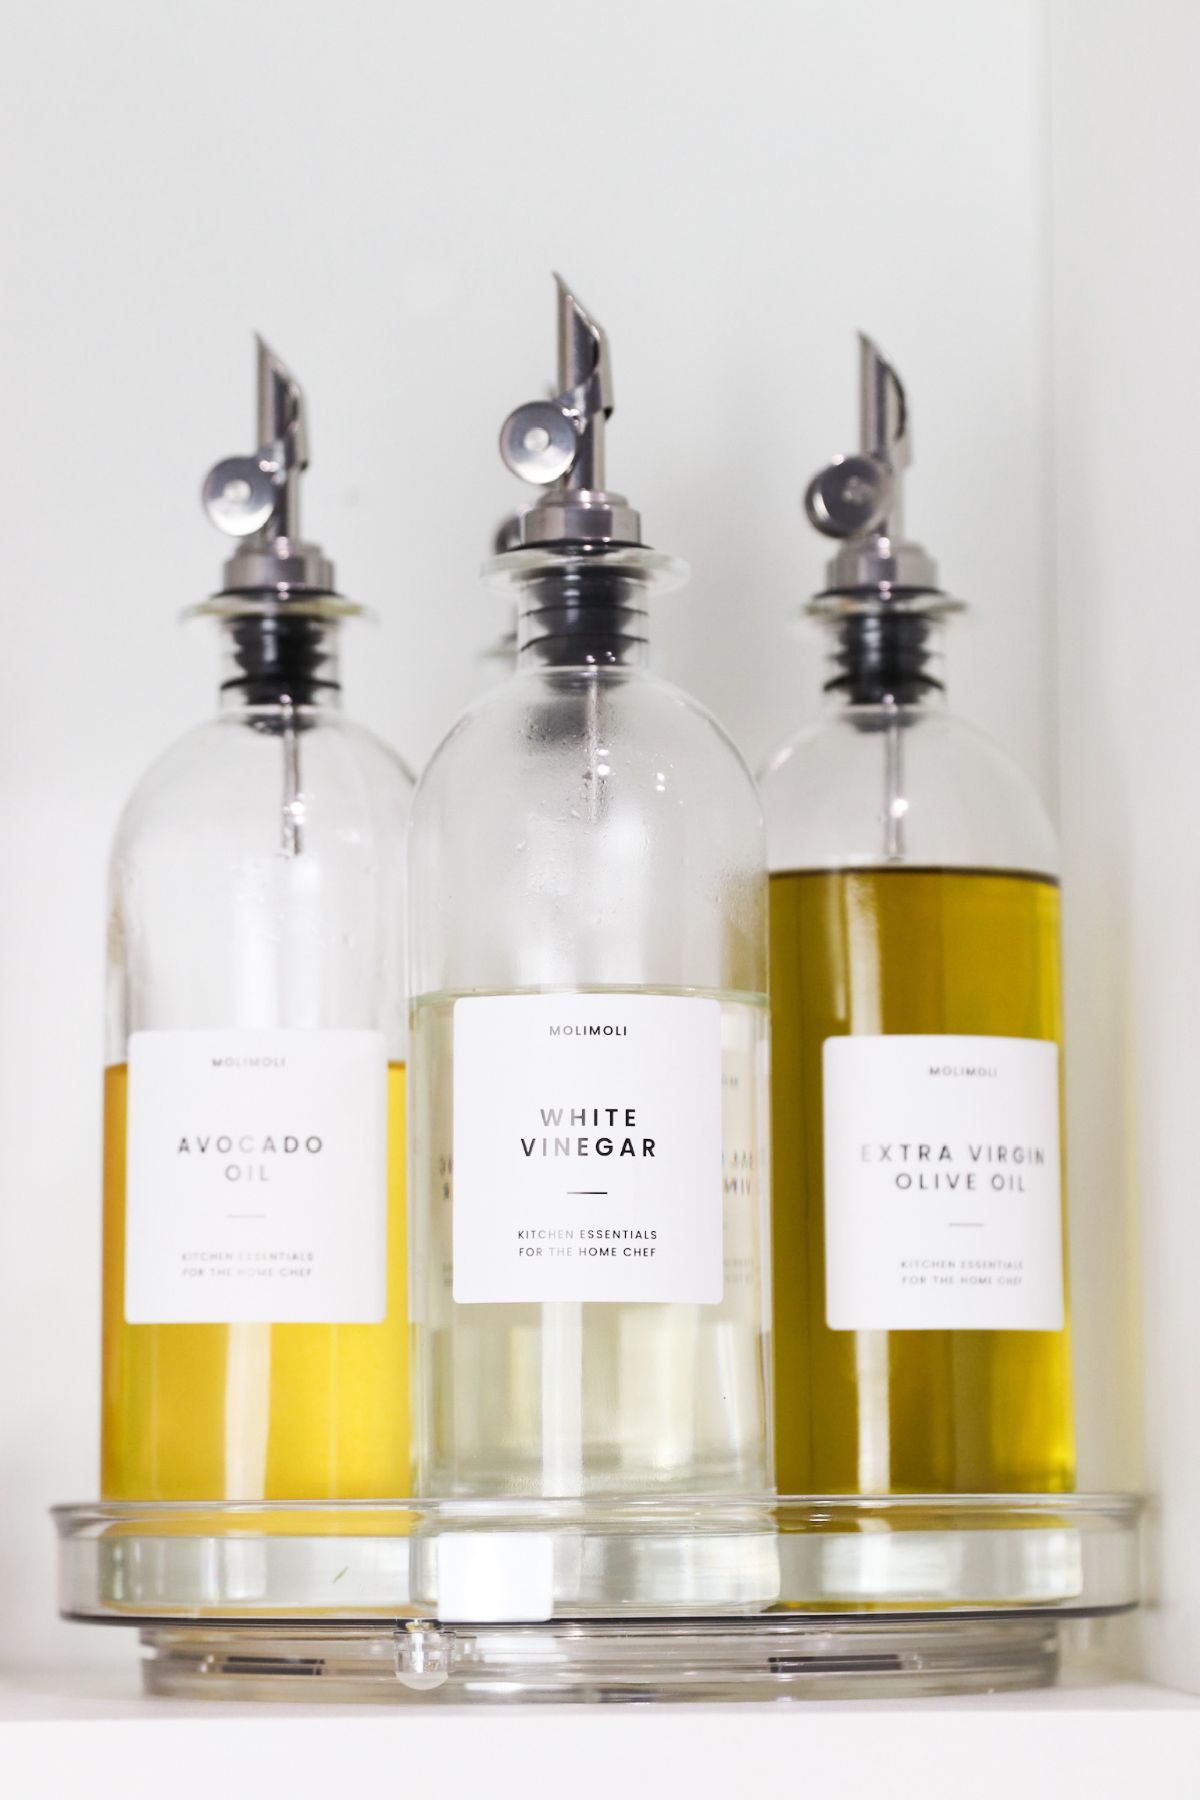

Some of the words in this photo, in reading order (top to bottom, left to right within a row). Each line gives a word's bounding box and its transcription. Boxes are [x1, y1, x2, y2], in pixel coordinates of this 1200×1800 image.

[549, 1025, 627, 1036] MOLIMOLI
[929, 1066, 998, 1077] MOLIMOLI
[540, 1108, 636, 1127] WHITE
[177, 1135, 323, 1154] AVOCADO
[520, 1137, 656, 1157] VINEGAR
[860, 1144, 953, 1163] EXTRA
[968, 1144, 1045, 1165] VIRGIN
[224, 1164, 269, 1182] OIL
[895, 1173, 977, 1191] OLIVE
[991, 1173, 1025, 1193] OIL
[518, 1229, 574, 1240] KITCHEN
[579, 1229, 658, 1240] ESSENTIALS
[518, 1247, 543, 1257] FOR
[549, 1247, 573, 1257] THE
[578, 1247, 618, 1257] HOME
[623, 1247, 656, 1257] CHEF
[901, 1259, 956, 1270] KITCHEN
[901, 1275, 927, 1286] FOR
[933, 1275, 954, 1286] THE
[960, 1275, 993, 1286] HOME
